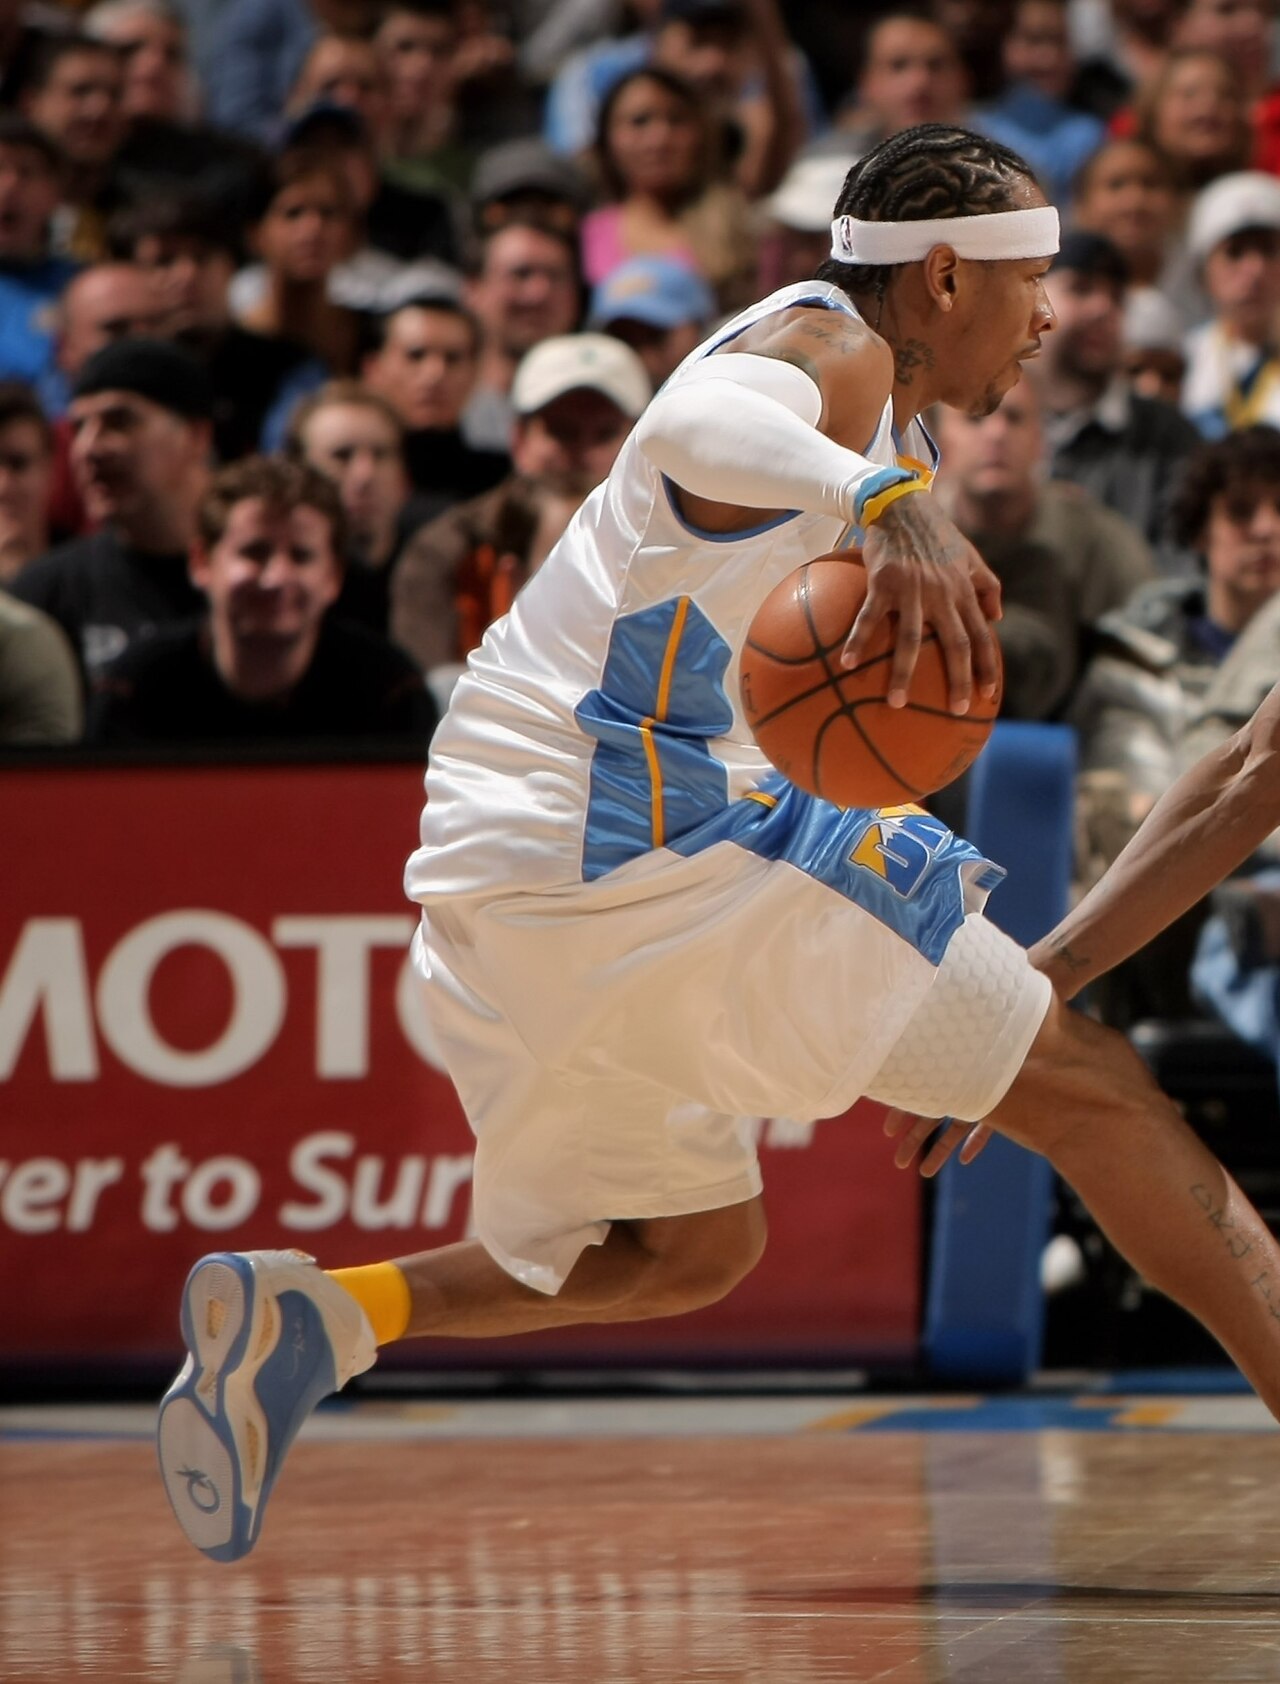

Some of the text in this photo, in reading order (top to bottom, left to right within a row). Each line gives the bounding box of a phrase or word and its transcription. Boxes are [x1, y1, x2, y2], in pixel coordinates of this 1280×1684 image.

[0, 1131, 476, 1235] er to Sur
